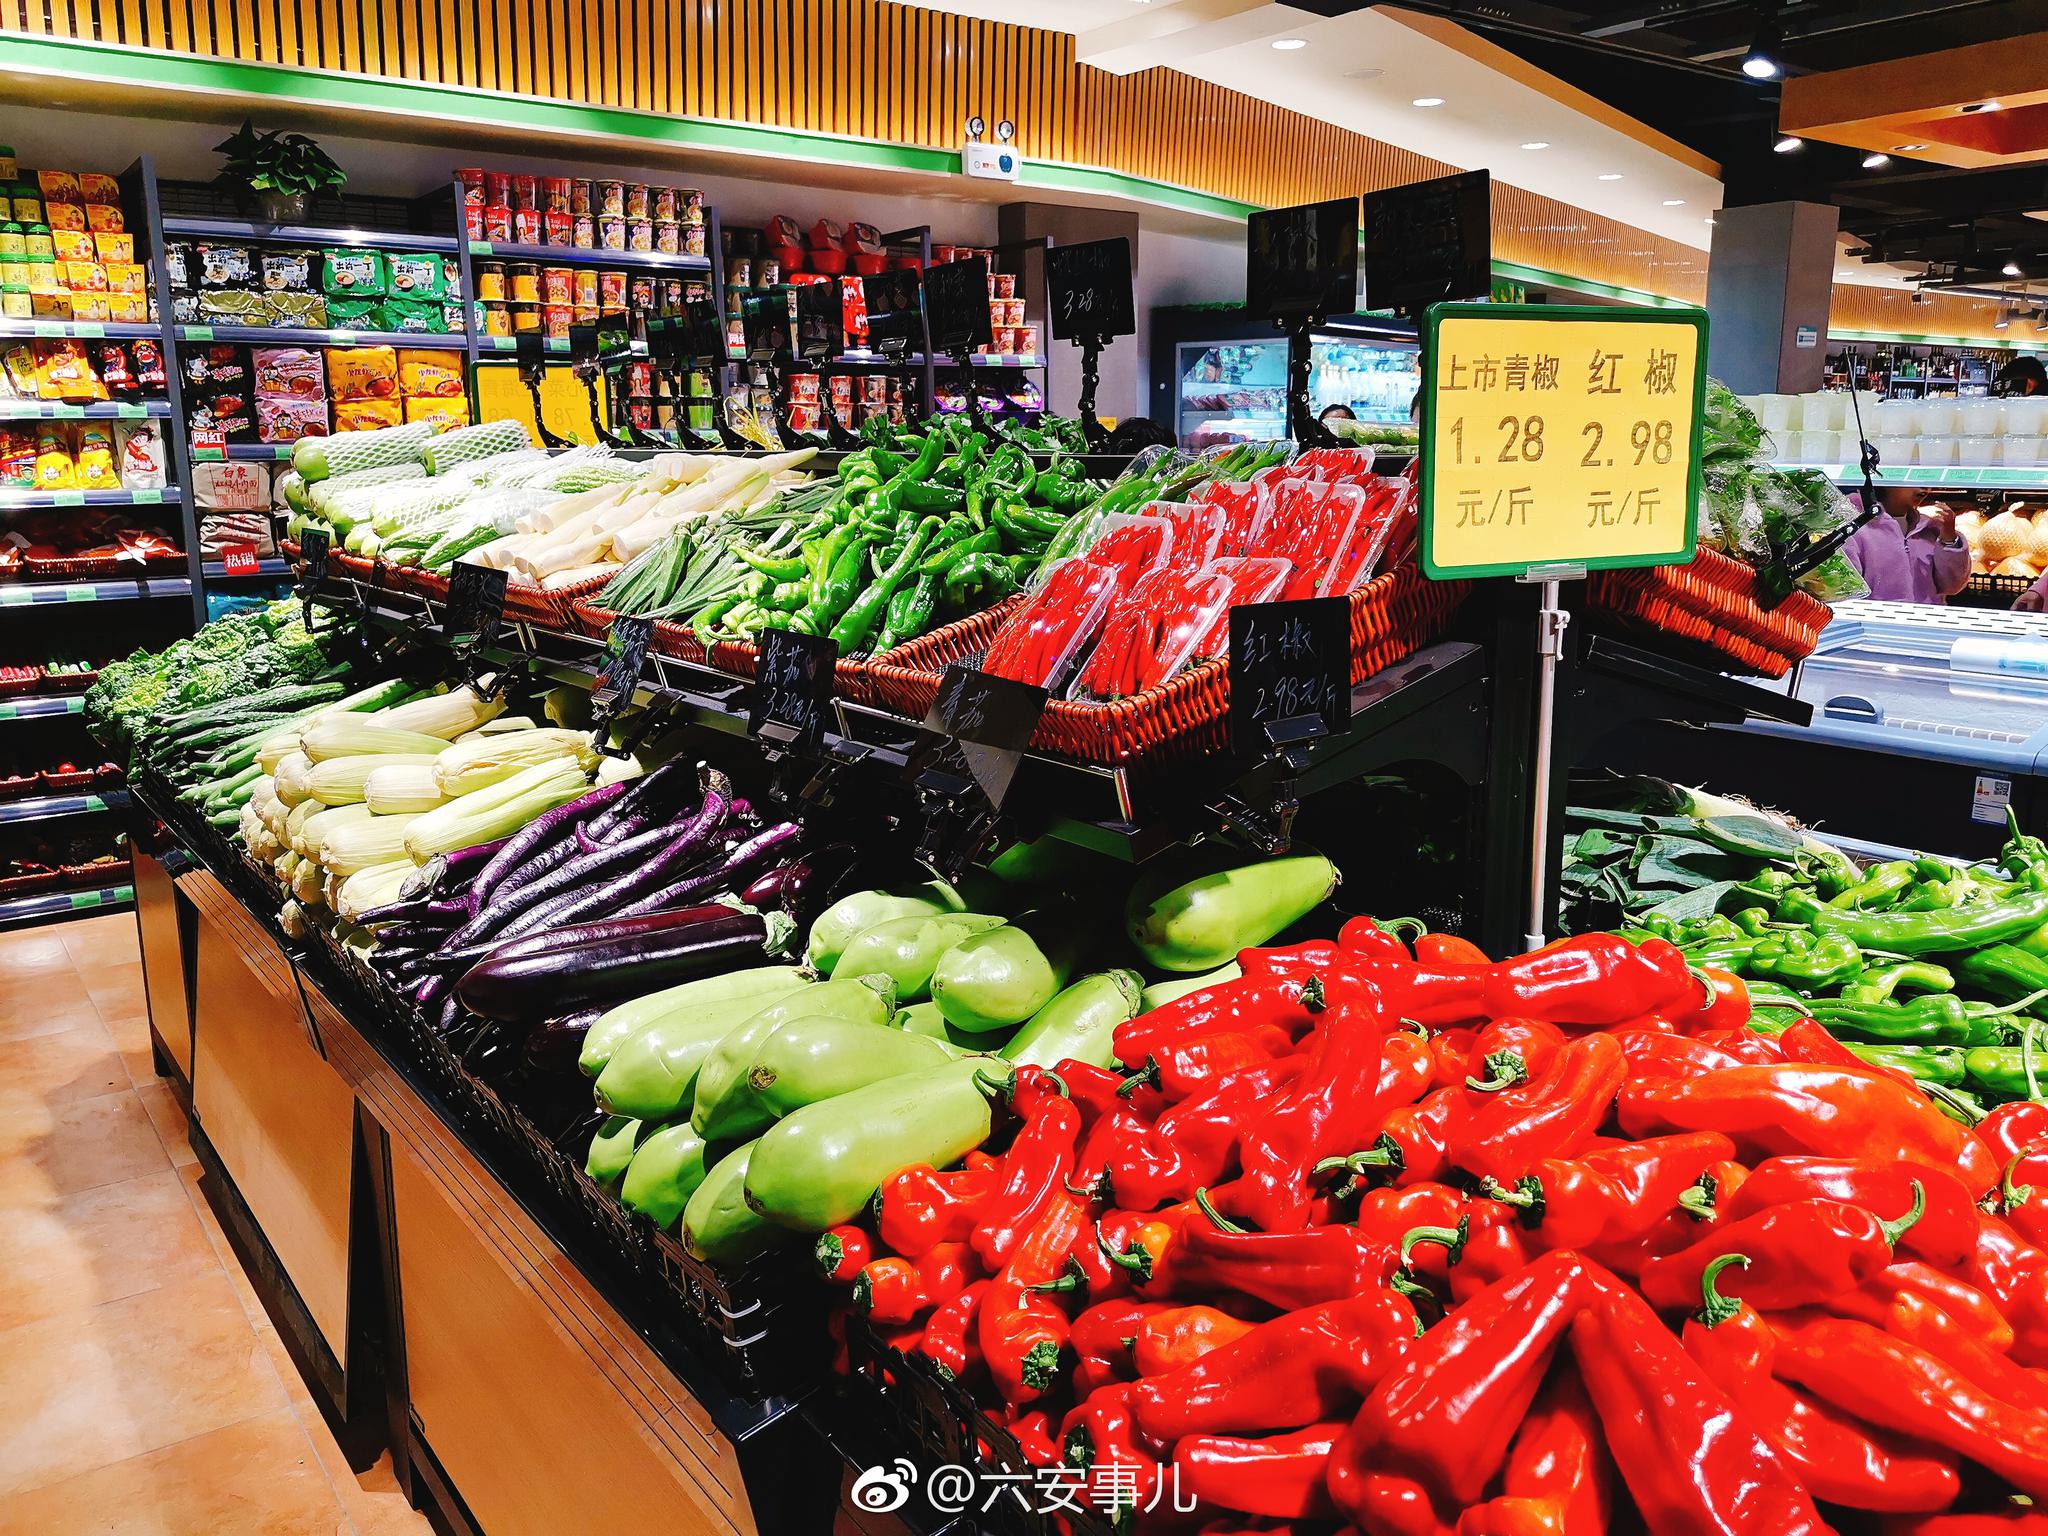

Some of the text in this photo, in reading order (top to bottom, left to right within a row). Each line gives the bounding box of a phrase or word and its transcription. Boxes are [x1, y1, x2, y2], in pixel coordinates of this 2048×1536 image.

[208, 253, 246, 265] 出前一丁
[266, 260, 305, 272] 出前一丁
[336, 261, 372, 271] 出前一丁
[397, 264, 432, 276] 出前一丁
[1439, 354, 1560, 392] 上市青椒
[193, 431, 224, 444] 网红
[1450, 415, 1673, 467] 1.28 2.98
[223, 466, 248, 480] 白象
[1456, 486, 1661, 528] 元/斤 元/斤
[225, 551, 255, 568] 热销
[1243, 617, 1316, 672] 红椒
[764, 633, 804, 687] 紫茄
[1252, 673, 1336, 721] 2.98元/斤
